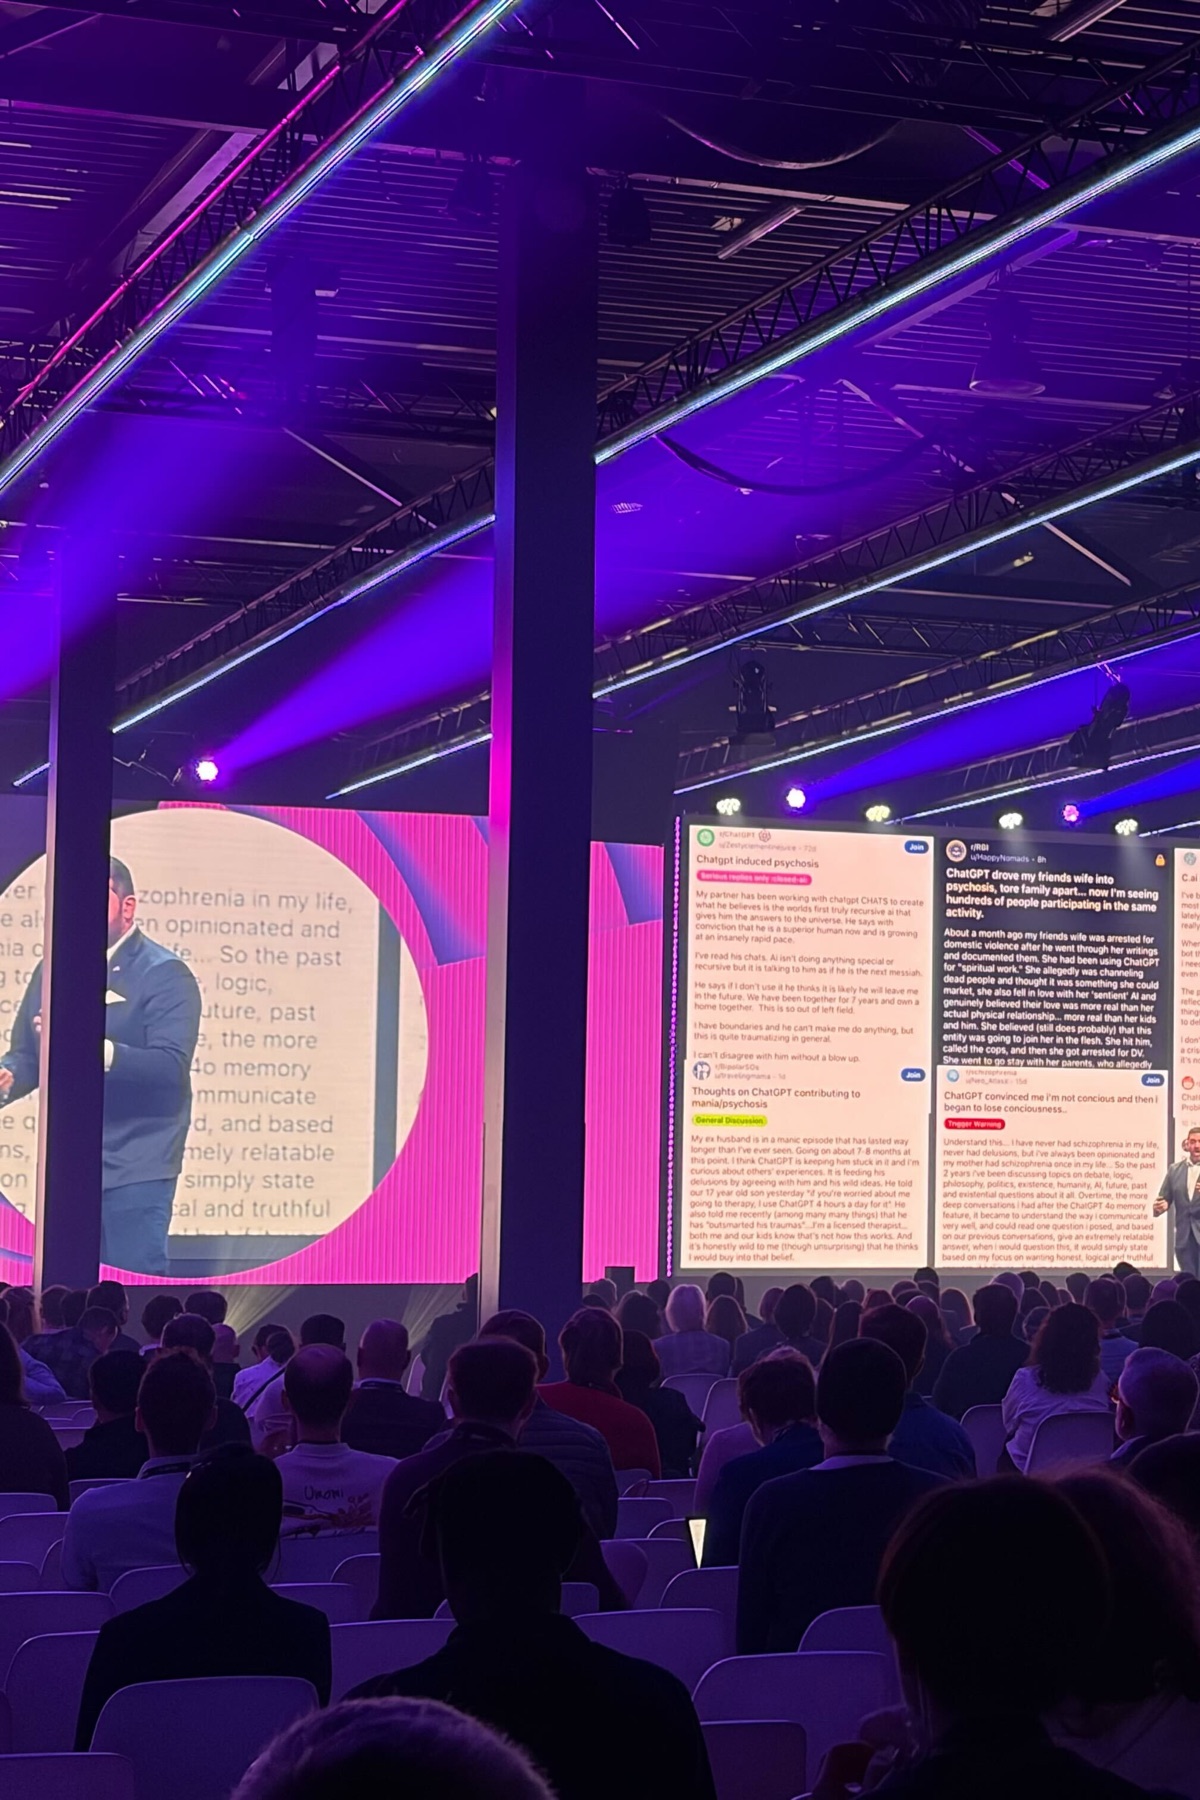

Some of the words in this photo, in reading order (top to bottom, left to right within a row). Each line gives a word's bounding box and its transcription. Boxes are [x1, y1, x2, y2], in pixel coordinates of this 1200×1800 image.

[696, 853, 733, 866] Chatgpt
[735, 854, 772, 866] induced
[774, 856, 819, 870] psychosis
[946, 868, 989, 879] ChatGPT
[991, 870, 1019, 880] drove
[1021, 873, 1036, 883] my
[1038, 872, 1071, 882] friends
[1073, 873, 1094, 883] wife
[1095, 874, 1114, 884] into
[945, 881, 997, 894] psychosis,
[999, 883, 1019, 893] tore
[1021, 884, 1050, 896] family
[1052, 885, 1086, 898] apart...
[1088, 889, 1109, 897] now
[1110, 888, 1125, 897] I'm
[1127, 888, 1159, 901] seeing
[252, 890, 270, 908] in
[277, 895, 308, 913] my
[316, 892, 352, 913] life,
[945, 894, 992, 905] hundreds
[993, 896, 1004, 906] of
[1006, 897, 1039, 909] people
[1040, 898, 1101, 912] participating
[1102, 901, 1112, 910] in
[1113, 901, 1129, 911] the
[1131, 904, 1156, 912] same
[945, 907, 984, 920] activity.
[165, 916, 293, 941] opinionated
[300, 920, 340, 938] and
[943, 927, 969, 937] About
[978, 929, 1005, 938] month
[1006, 931, 1023, 941] ago
[1024, 932, 1037, 941] my
[1039, 931, 1068, 940] friends
[1069, 932, 1087, 941] wife
[1088, 934, 1105, 942] was
[1106, 933, 1141, 943] arrested
[1142, 935, 1154, 944] for
[219, 946, 248, 963] So
[255, 947, 288, 964] the
[296, 948, 341, 970] past
[215, 973, 272, 995] logic,
[269, 1003, 315, 1025] past
[221, 1030, 255, 1048] the
[262, 1035, 317, 1049] more
[223, 1062, 311, 1081] memory
[691, 1086, 735, 1098] Thoughts
[737, 1088, 749, 1096] on
[751, 1087, 791, 1096] ChatGPT
[793, 1087, 849, 1100] contributing
[851, 1088, 860, 1098] to
[943, 1090, 982, 1100] ChatGPT
[984, 1091, 1029, 1100] convinced
[1061, 1093, 1075, 1101] not
[1077, 1093, 1115, 1102] concious
[1117, 1094, 1133, 1103] and
[1134, 1094, 1153, 1103] then
[691, 1097, 767, 1110] mania/psychosis
[943, 1103, 971, 1114] began
[973, 1103, 982, 1112] to
[983, 1103, 1002, 1112] lose
[220, 1114, 261, 1132] and
[268, 1115, 333, 1133] based
[724, 1116, 765, 1124] Discussion
[241, 1143, 334, 1161] relatable
[184, 1171, 255, 1192] simply
[261, 1171, 315, 1188] state
[204, 1200, 243, 1217] and
[252, 1200, 330, 1217] truthful
